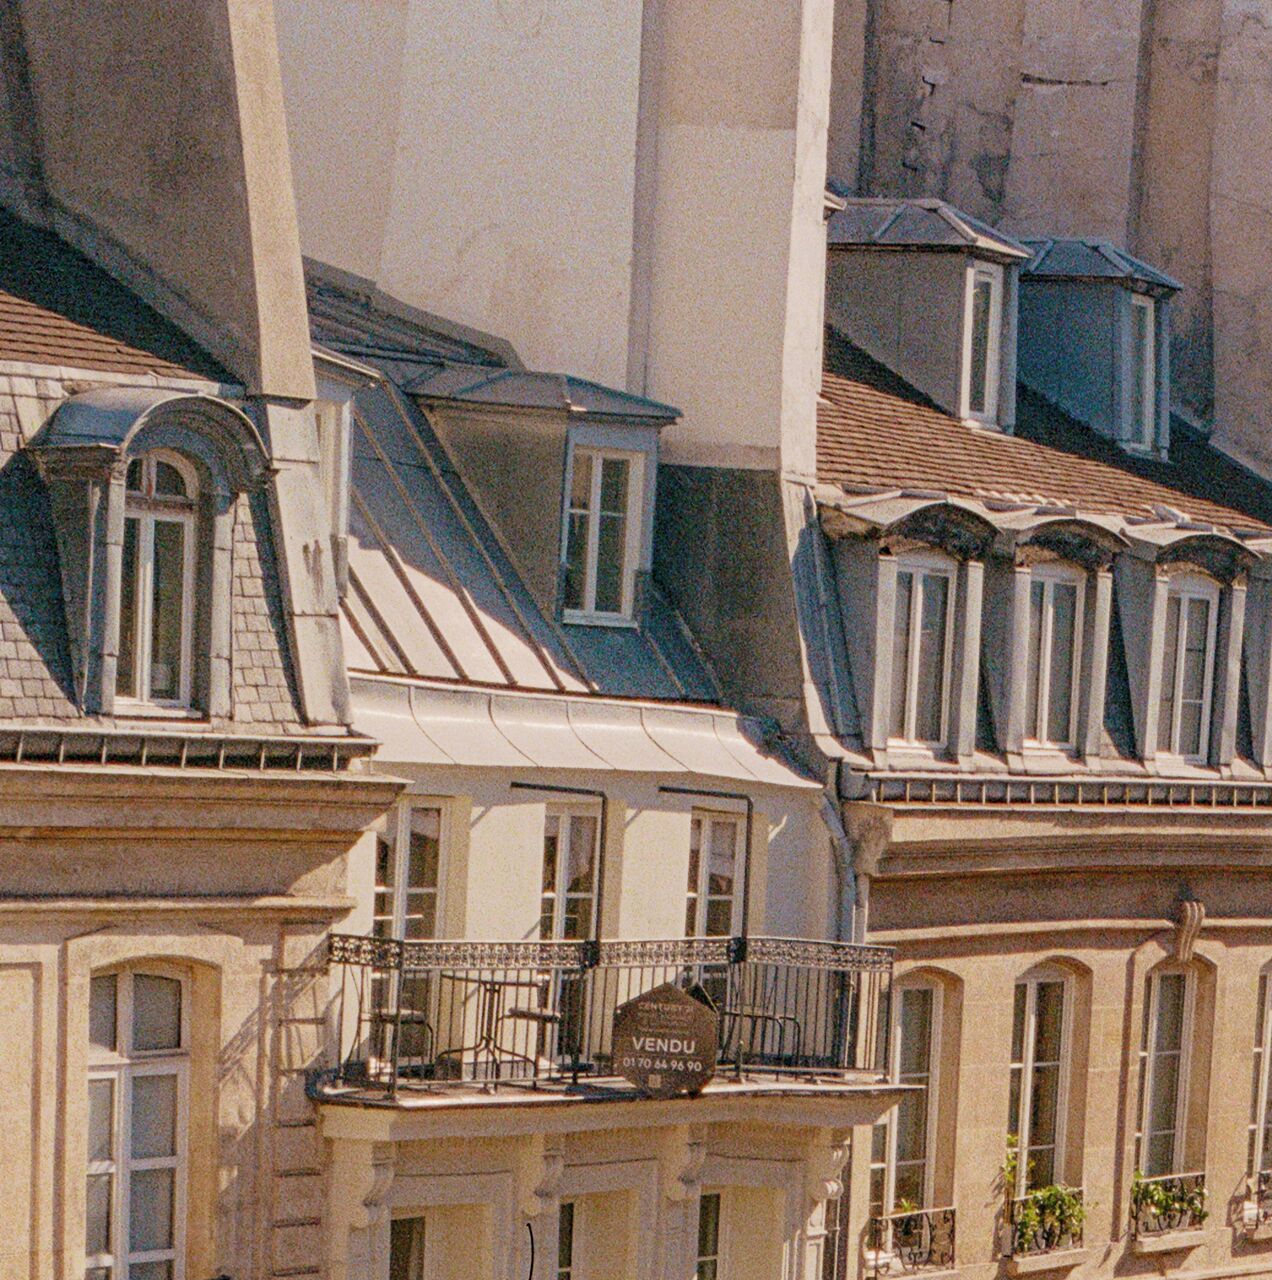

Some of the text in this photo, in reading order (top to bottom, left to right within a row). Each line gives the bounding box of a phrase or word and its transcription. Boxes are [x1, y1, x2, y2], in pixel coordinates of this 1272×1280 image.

[633, 1036, 695, 1054] VENDU
[623, 1057, 702, 1072] 01 70 64 96 90
